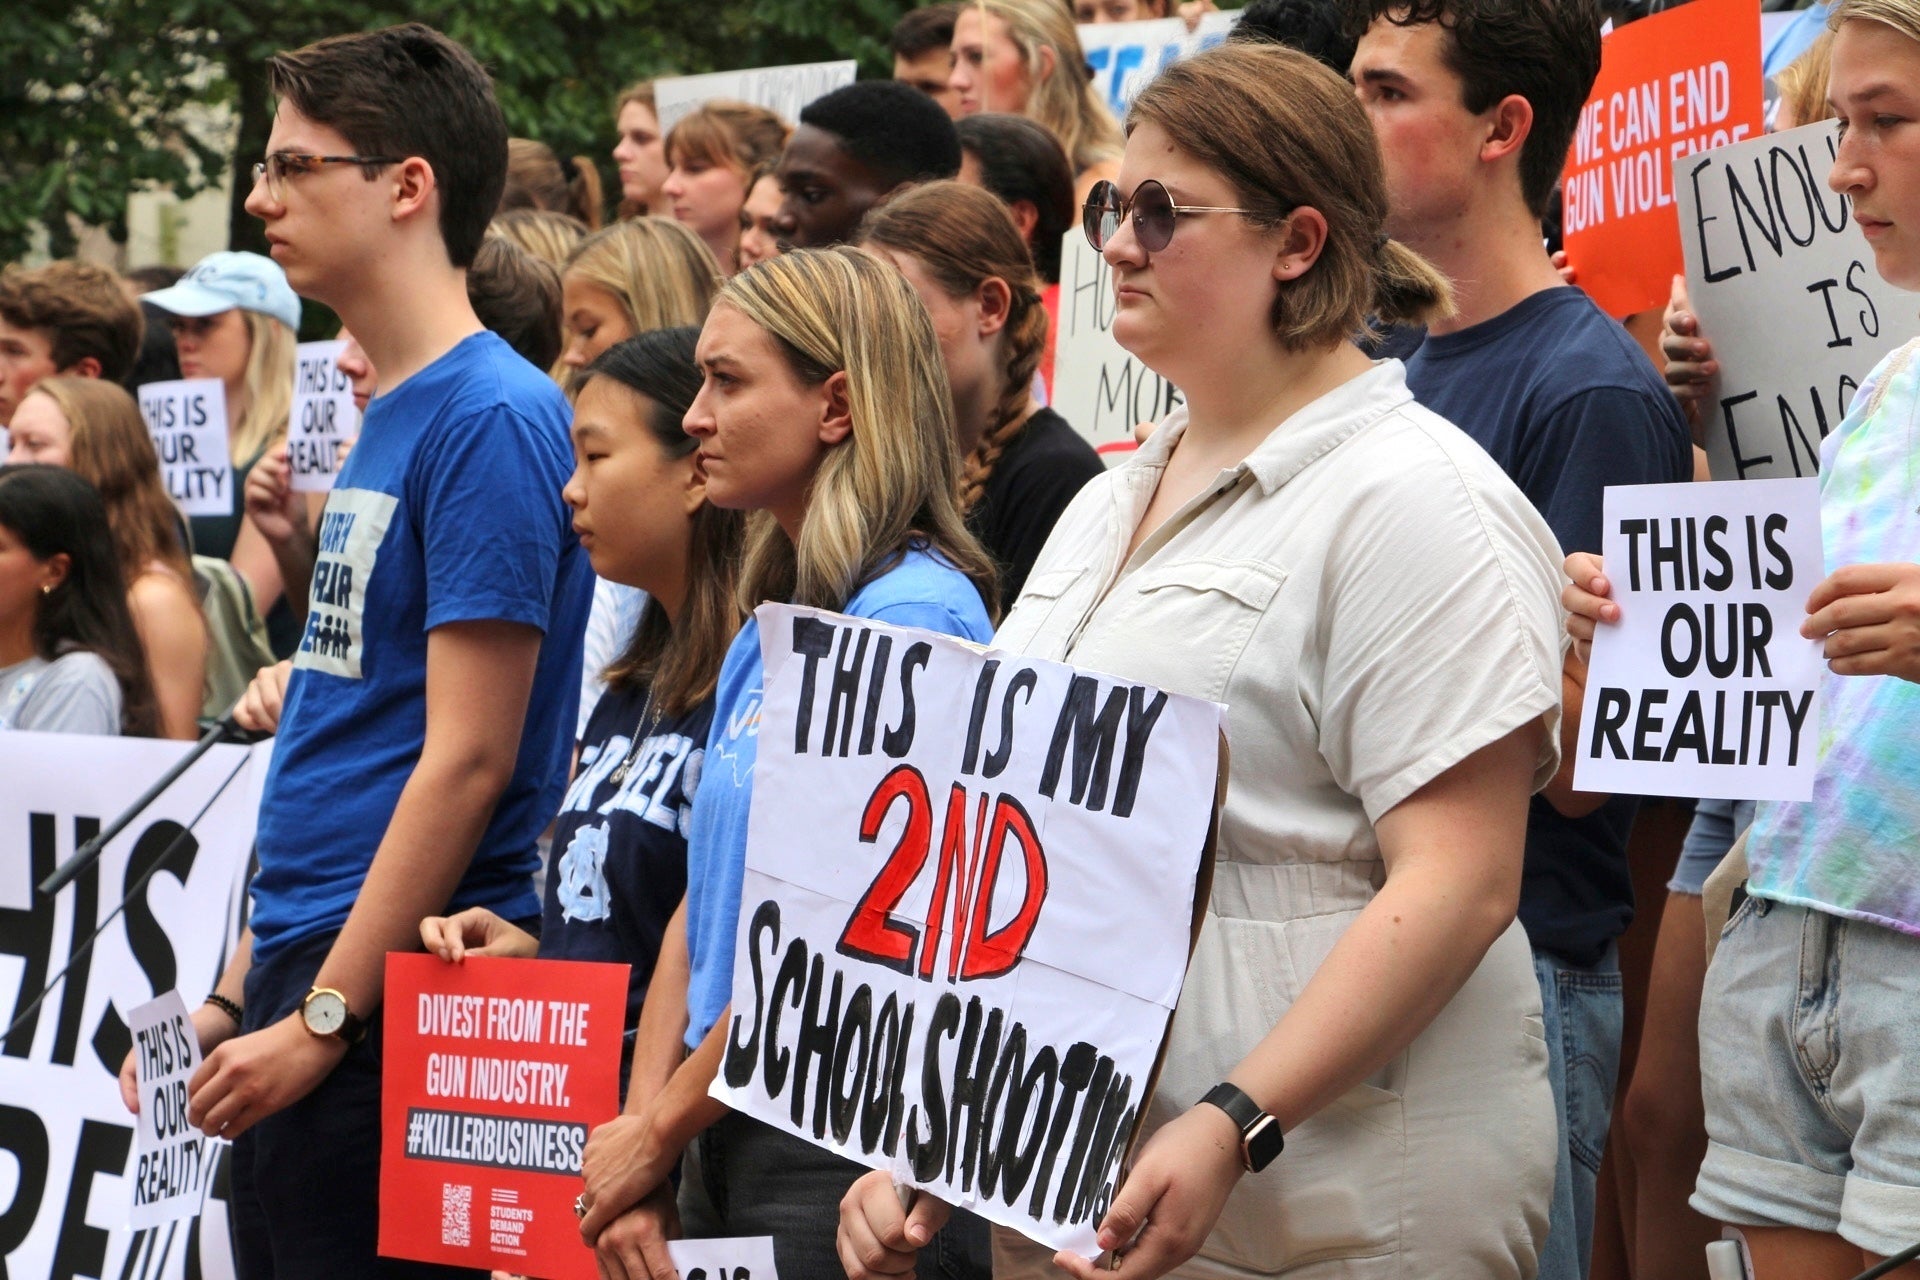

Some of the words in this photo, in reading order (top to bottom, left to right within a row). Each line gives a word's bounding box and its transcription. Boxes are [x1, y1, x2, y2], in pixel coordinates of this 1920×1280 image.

[1575, 98, 1604, 166] WE
[1609, 91, 1660, 153] CAN
[1669, 60, 1730, 135] END
[1565, 165, 1605, 235] GUN
[1610, 123, 1750, 219] VIOL
[1690, 135, 1852, 283] ENOU
[1806, 260, 1879, 348] IS
[183, 394, 207, 426] IS
[302, 399, 337, 434] OUR
[154, 433, 199, 464] UR
[288, 439, 342, 474] REALIT
[168, 466, 226, 500] LITY
[1620, 515, 1733, 592] THIS
[1745, 513, 1794, 591] IS
[1660, 602, 1774, 680] OUR
[792, 616, 933, 759] THIS
[961, 659, 1038, 779] IS
[1038, 672, 1169, 819] MY
[1590, 687, 1815, 767] REALITY
[835, 763, 1049, 985] 2ND
[0, 811, 199, 1079] HIS
[137, 1020, 173, 1082] THIS
[170, 1014, 192, 1070] IS
[417, 992, 485, 1039] DIVEST
[487, 995, 544, 1044] FROM
[548, 1001, 590, 1047] THE
[723, 899, 915, 1162] SCHOOL
[154, 1079, 189, 1141] OUR
[426, 1052, 467, 1097] GUN
[470, 1056, 570, 1108] INDUSTRY.
[134, 1137, 206, 1207] REALITY
[407, 1112, 585, 1172] #KILLERBUSINESS
[490, 1205, 534, 1222] STUDENTS
[490, 1218, 525, 1234] DEMAND
[490, 1232, 520, 1247] ACTION
